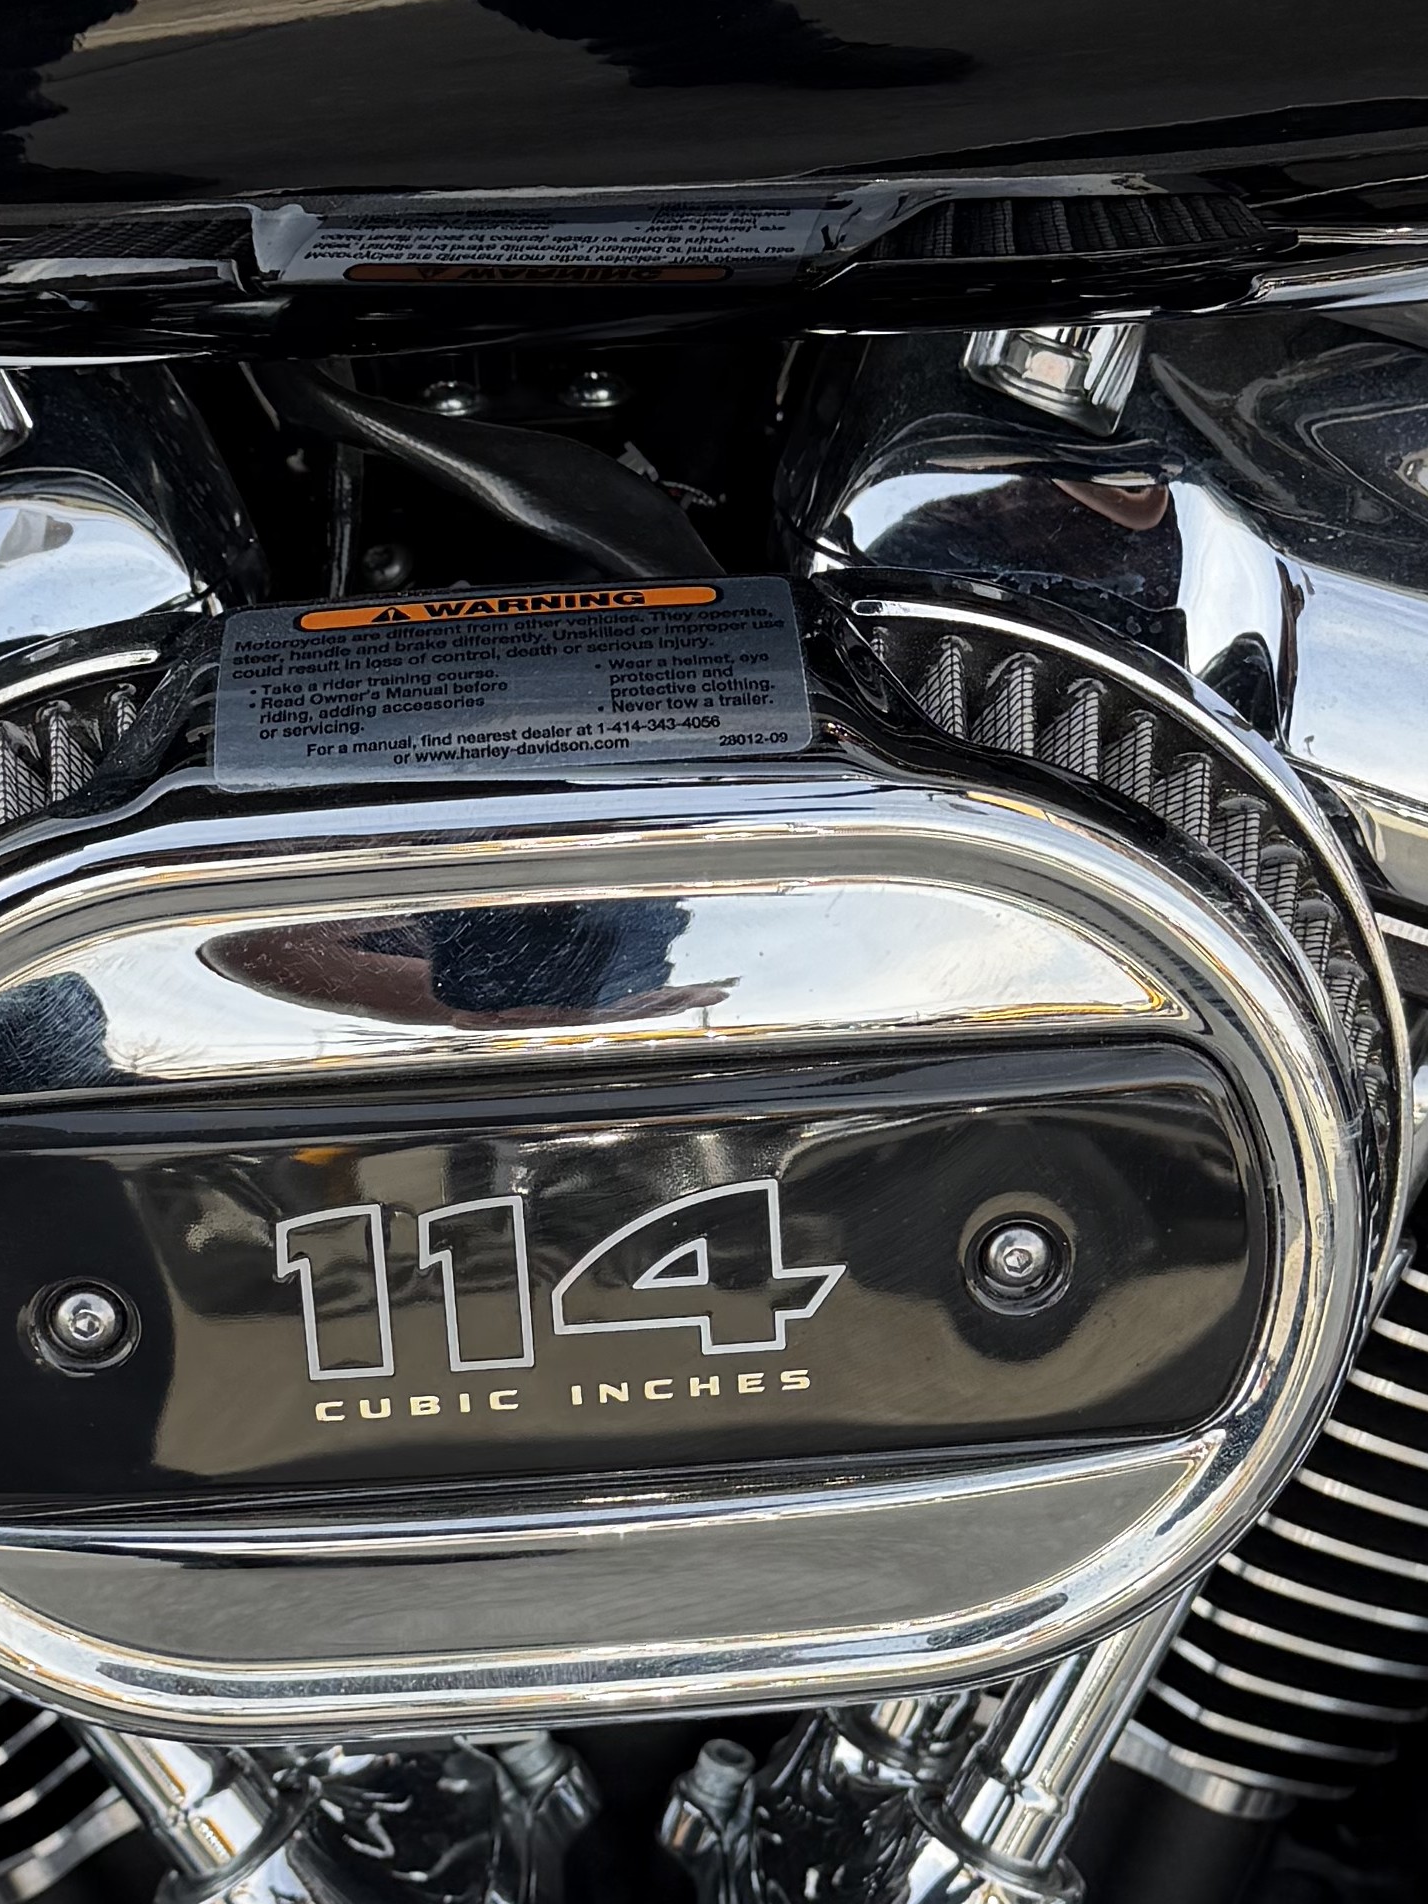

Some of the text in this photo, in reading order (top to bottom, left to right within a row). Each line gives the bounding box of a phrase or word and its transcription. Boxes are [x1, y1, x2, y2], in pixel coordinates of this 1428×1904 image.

[424, 591, 645, 617] WARNING
[232, 651, 284, 666] steer,
[292, 646, 351, 660] handle
[356, 641, 389, 655] and
[395, 637, 447, 653] brake
[452, 631, 547, 648] differently.
[552, 625, 636, 641] Unskilled
[640, 625, 659, 636] or
[752, 619, 785, 630] use
[232, 665, 283, 680] could
[288, 660, 340, 675] result
[345, 659, 360, 671] in
[365, 656, 403, 669] loss
[408, 653, 427, 665] of
[506, 643, 557, 657] death
[562, 641, 581, 654] or
[587, 639, 653, 652] serious
[659, 635, 714, 651] injury.
[608, 657, 652, 671] Wear
[657, 657, 667, 668] a
[739, 652, 769, 664] eye
[261, 682, 303, 696] Take
[307, 682, 318, 692] a
[322, 677, 363, 691] rider
[368, 672, 432, 688] training
[609, 666, 733, 685] protection and
[260, 679, 509, 710] Read Owner's Manual before
[610, 682, 696, 698] protective
[259, 696, 485, 726] riding, adding accessories
[612, 693, 774, 714] Never tow a trailer.
[259, 720, 365, 740] or servicing.
[306, 743, 334, 757] For
[338, 743, 348, 754] a
[353, 736, 417, 753] manual,
[421, 734, 452, 747] find
[457, 729, 518, 744] nearest
[522, 725, 572, 740] dealer
[576, 724, 592, 736] at
[393, 754, 410, 765] or
[275, 1178, 847, 1381] 114
[315, 1369, 812, 1422] CUBIC INCHES
